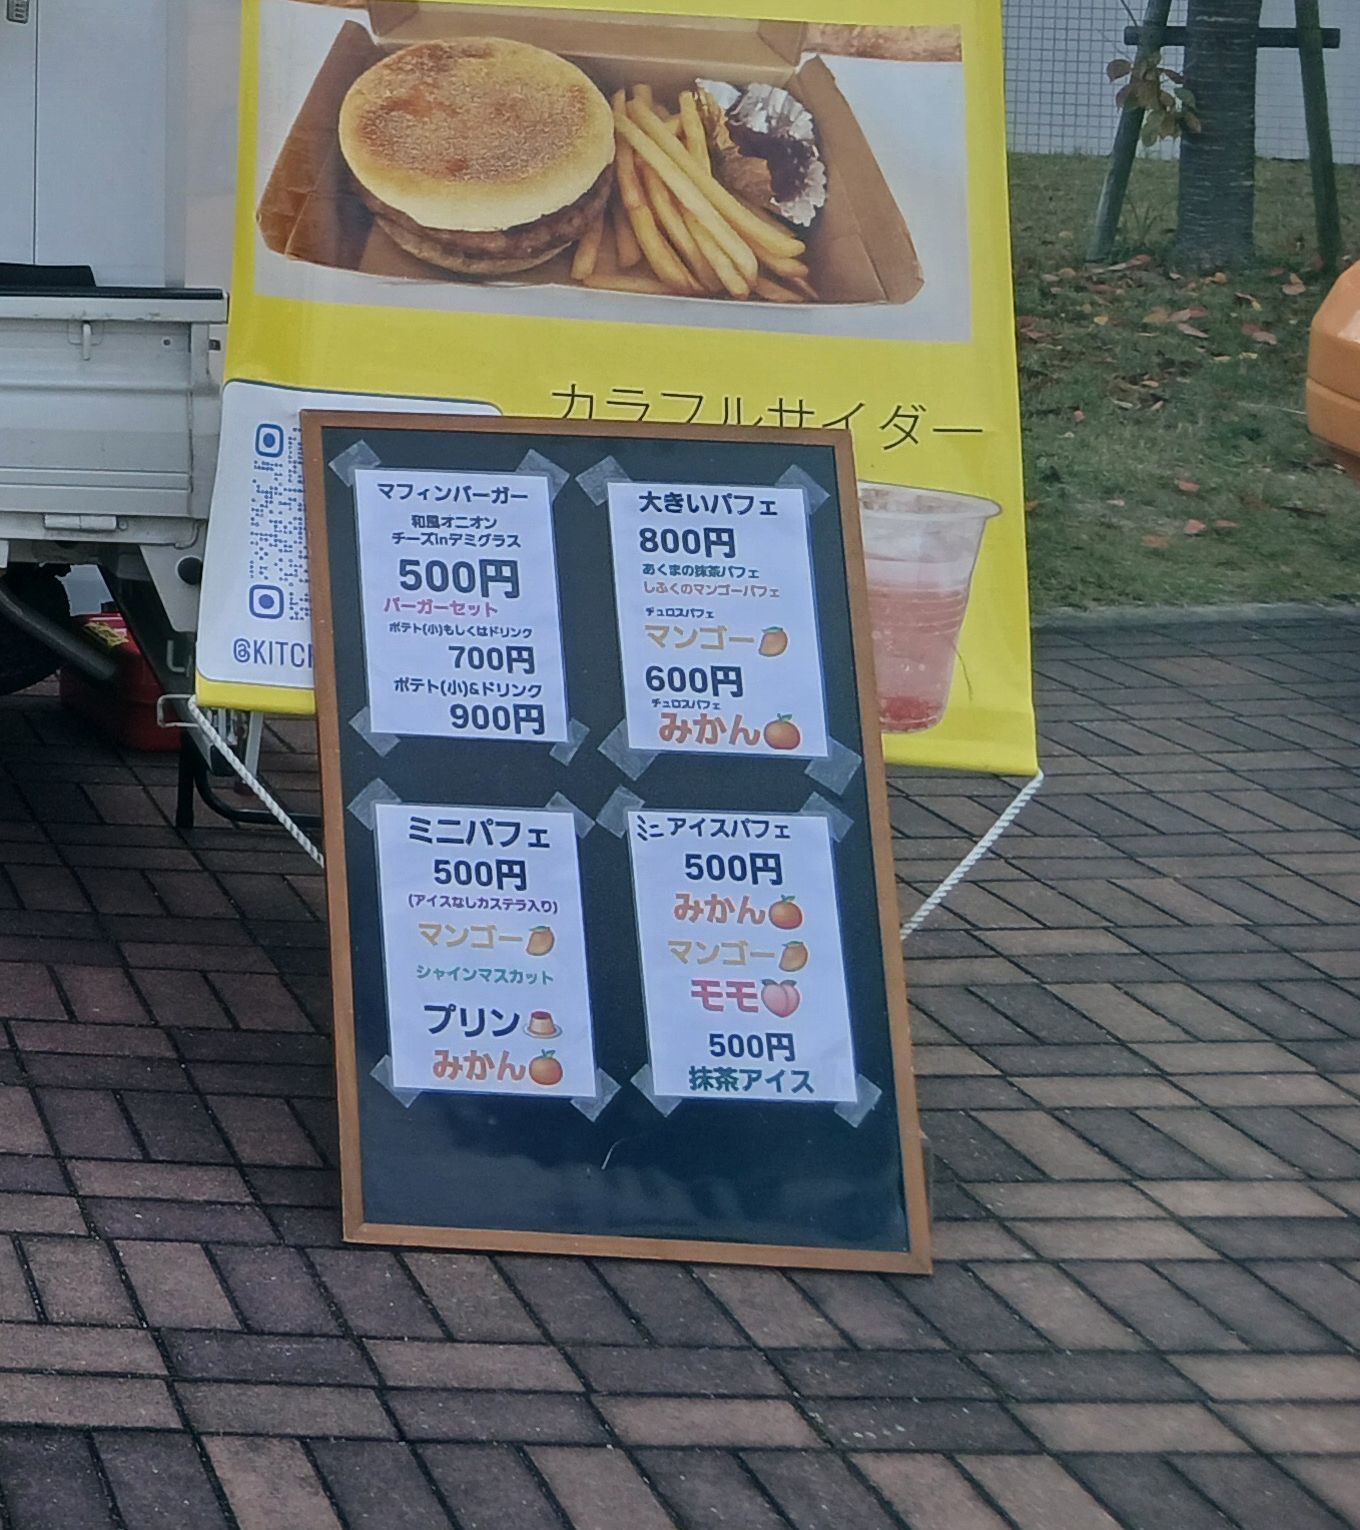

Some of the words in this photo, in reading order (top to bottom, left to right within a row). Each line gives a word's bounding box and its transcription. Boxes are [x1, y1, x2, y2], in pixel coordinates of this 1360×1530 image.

[551, 383, 983, 451] カラフルサイダー
[377, 483, 528, 504] マフィンバーガー
[638, 491, 778, 516] 大きいパフェ
[411, 514, 497, 530] 和風オニオン
[392, 532, 521, 548] チーズinデミグラス
[639, 527, 736, 559] 800円
[399, 558, 520, 598] 500円
[642, 563, 759, 579] あくまの抹茶パフェ
[643, 581, 780, 598] しふくのマンゴーパフェ
[383, 597, 498, 618] バーガーセット
[389, 622, 532, 639] ポテト(小)もしくはドリンク
[644, 625, 755, 650] マンゴー
[448, 645, 535, 674] 700円
[393, 677, 542, 699] ポテト(小)&ドリンク
[645, 665, 744, 698] 600円
[450, 703, 545, 735] 900円
[659, 712, 760, 746] みかん
[409, 816, 550, 848] ミニパフェ
[433, 859, 527, 891] 500円
[685, 852, 783, 886] 500円
[408, 893, 559, 914] (アイスなしカステラ入り)
[674, 893, 766, 924] みかん
[418, 923, 523, 949] マンゴー
[668, 939, 776, 966] マンゴー
[416, 965, 554, 985] シャインマスカット
[690, 979, 759, 1013] モモ
[423, 1003, 520, 1037] プリン
[709, 1033, 795, 1062] 500円
[433, 1049, 526, 1081] みかん
[689, 1065, 815, 1094] 抹茶アイス
